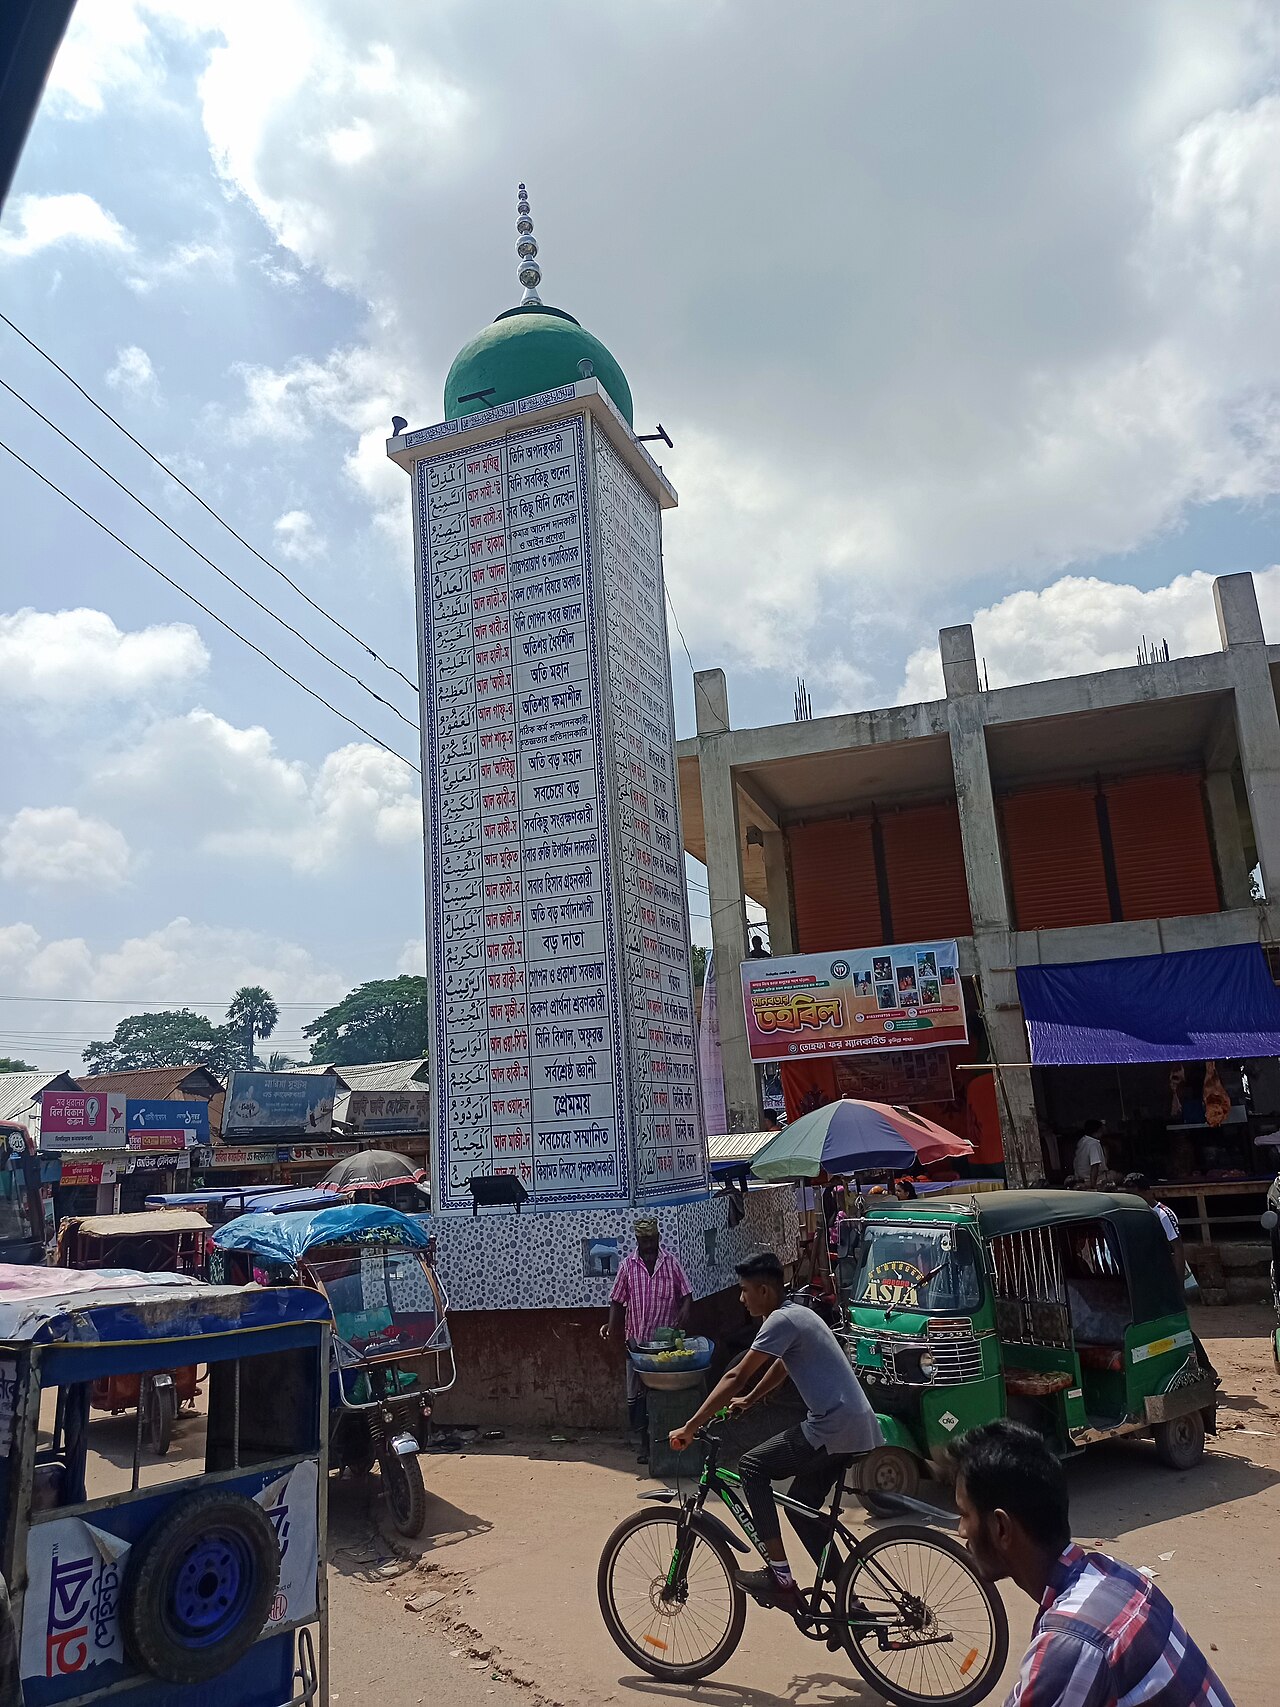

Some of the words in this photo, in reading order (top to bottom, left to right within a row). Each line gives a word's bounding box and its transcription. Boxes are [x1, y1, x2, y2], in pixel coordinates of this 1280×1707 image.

[467, 459, 480, 474] আল
[468, 489, 478, 502] আস
[469, 515, 481, 529] আল
[470, 540, 483, 557] আল
[472, 568, 484, 590] আল
[473, 597, 485, 612] আল
[474, 621, 487, 640] আল
[476, 651, 488, 666] আল
[476, 678, 488, 695] আল
[478, 706, 491, 721] আল
[481, 764, 491, 778] আল
[482, 793, 494, 811] আল
[483, 824, 496, 839] আল
[484, 852, 498, 867] আল
[485, 882, 498, 900] আল
[486, 912, 498, 930] আল
[487, 942, 500, 962] আল
[488, 972, 500, 990] আর
[489, 1004, 503, 1021] আল
[754, 995, 840, 1030] তহবিল
[490, 1035, 501, 1054] আল
[800, 1042, 825, 1052] তোহফা
[829, 1041, 842, 1049] ফর
[491, 1067, 504, 1083] আল
[50, 1106, 62, 1116] বিল
[64, 1106, 84, 1116] বিকাশ
[492, 1099, 505, 1116] আল
[493, 1133, 507, 1152] আল
[862, 1282, 919, 1306] ASIA
[732, 1504, 770, 1560] SUPRE
